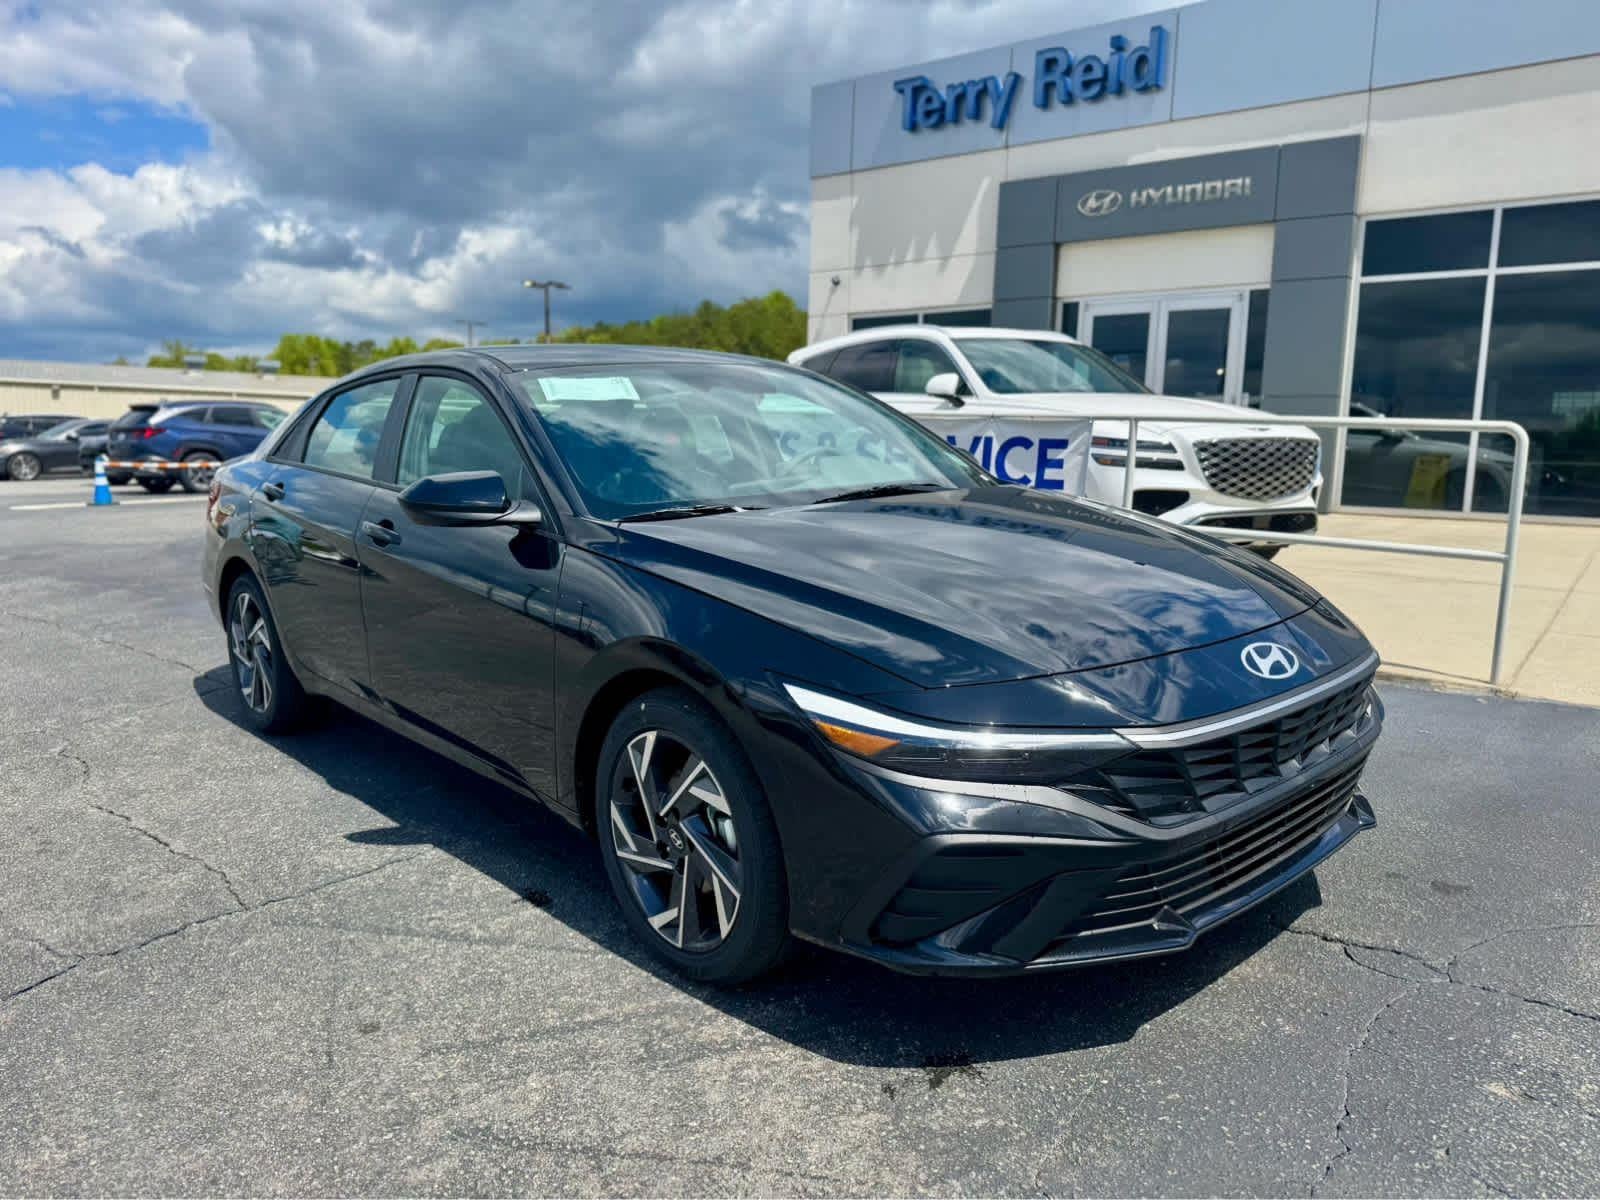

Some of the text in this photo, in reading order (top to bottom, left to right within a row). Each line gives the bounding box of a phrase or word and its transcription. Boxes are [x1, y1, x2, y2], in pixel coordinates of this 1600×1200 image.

[893, 25, 1168, 131] Terry Reid
[1130, 176, 1252, 208] HYUNDAI
